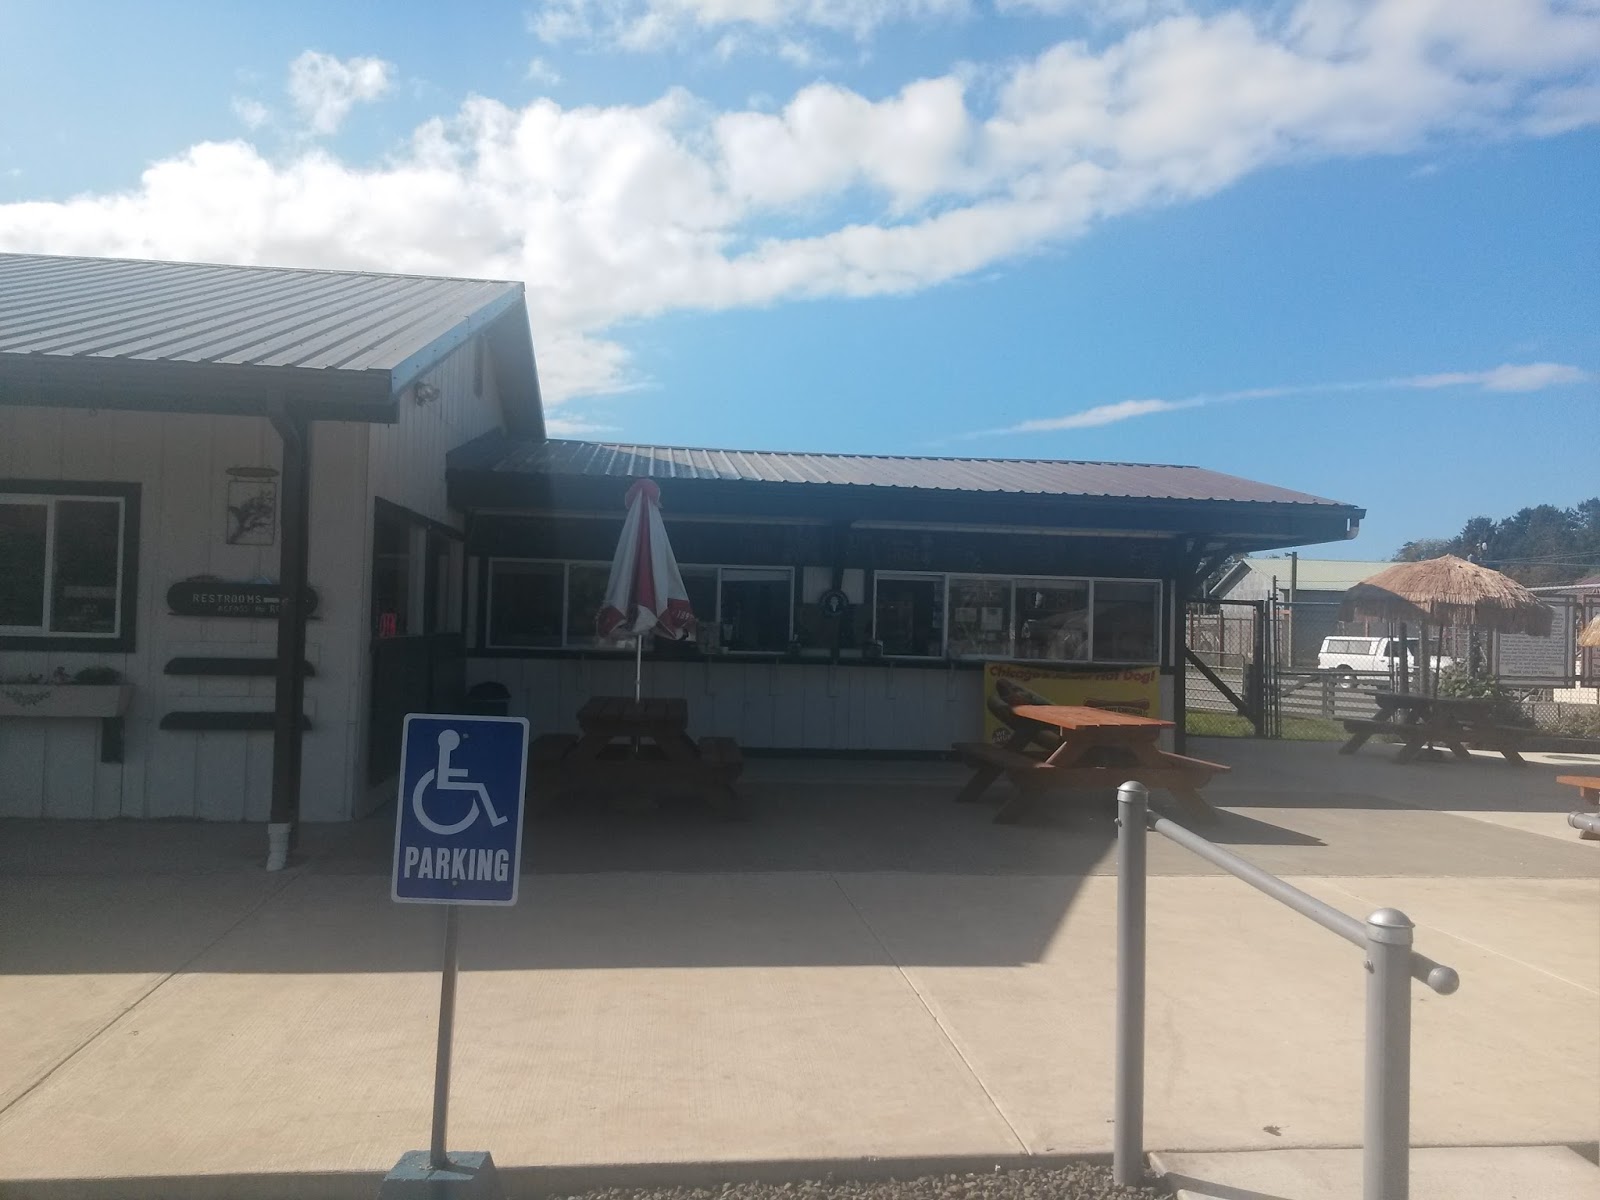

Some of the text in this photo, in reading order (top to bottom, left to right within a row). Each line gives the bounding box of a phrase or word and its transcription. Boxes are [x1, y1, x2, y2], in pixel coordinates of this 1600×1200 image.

[192, 593, 262, 603] RESTROOMS
[1123, 669, 1156, 684] Dog!
[404, 846, 510, 882] PARKING
